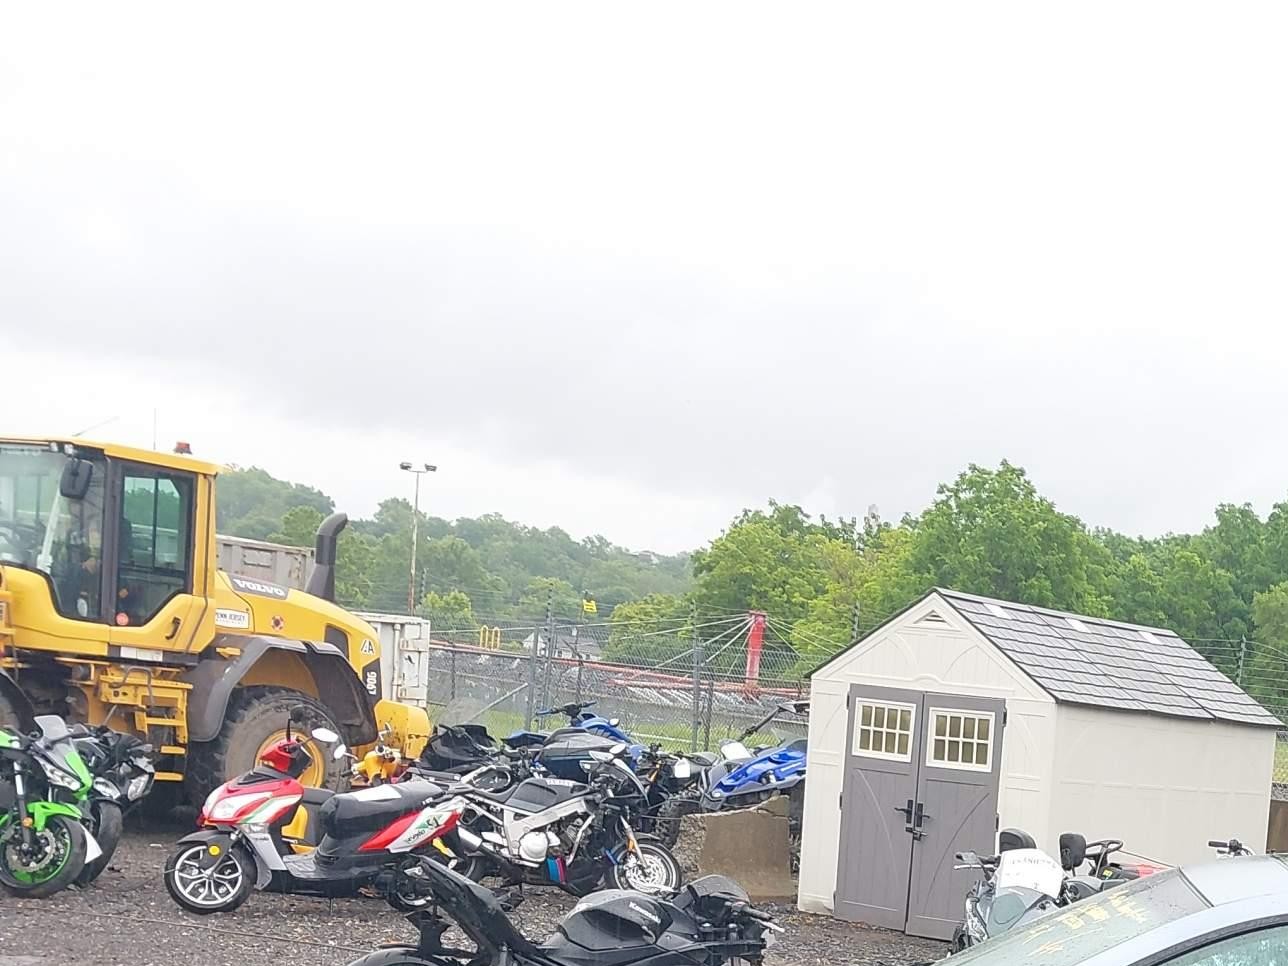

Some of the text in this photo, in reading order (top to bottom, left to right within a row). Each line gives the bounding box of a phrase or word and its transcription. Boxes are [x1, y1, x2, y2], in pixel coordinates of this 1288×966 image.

[233, 578, 285, 597] VOLVO
[366, 671, 377, 695] L90G
[629, 901, 661, 923] Kawasaki
